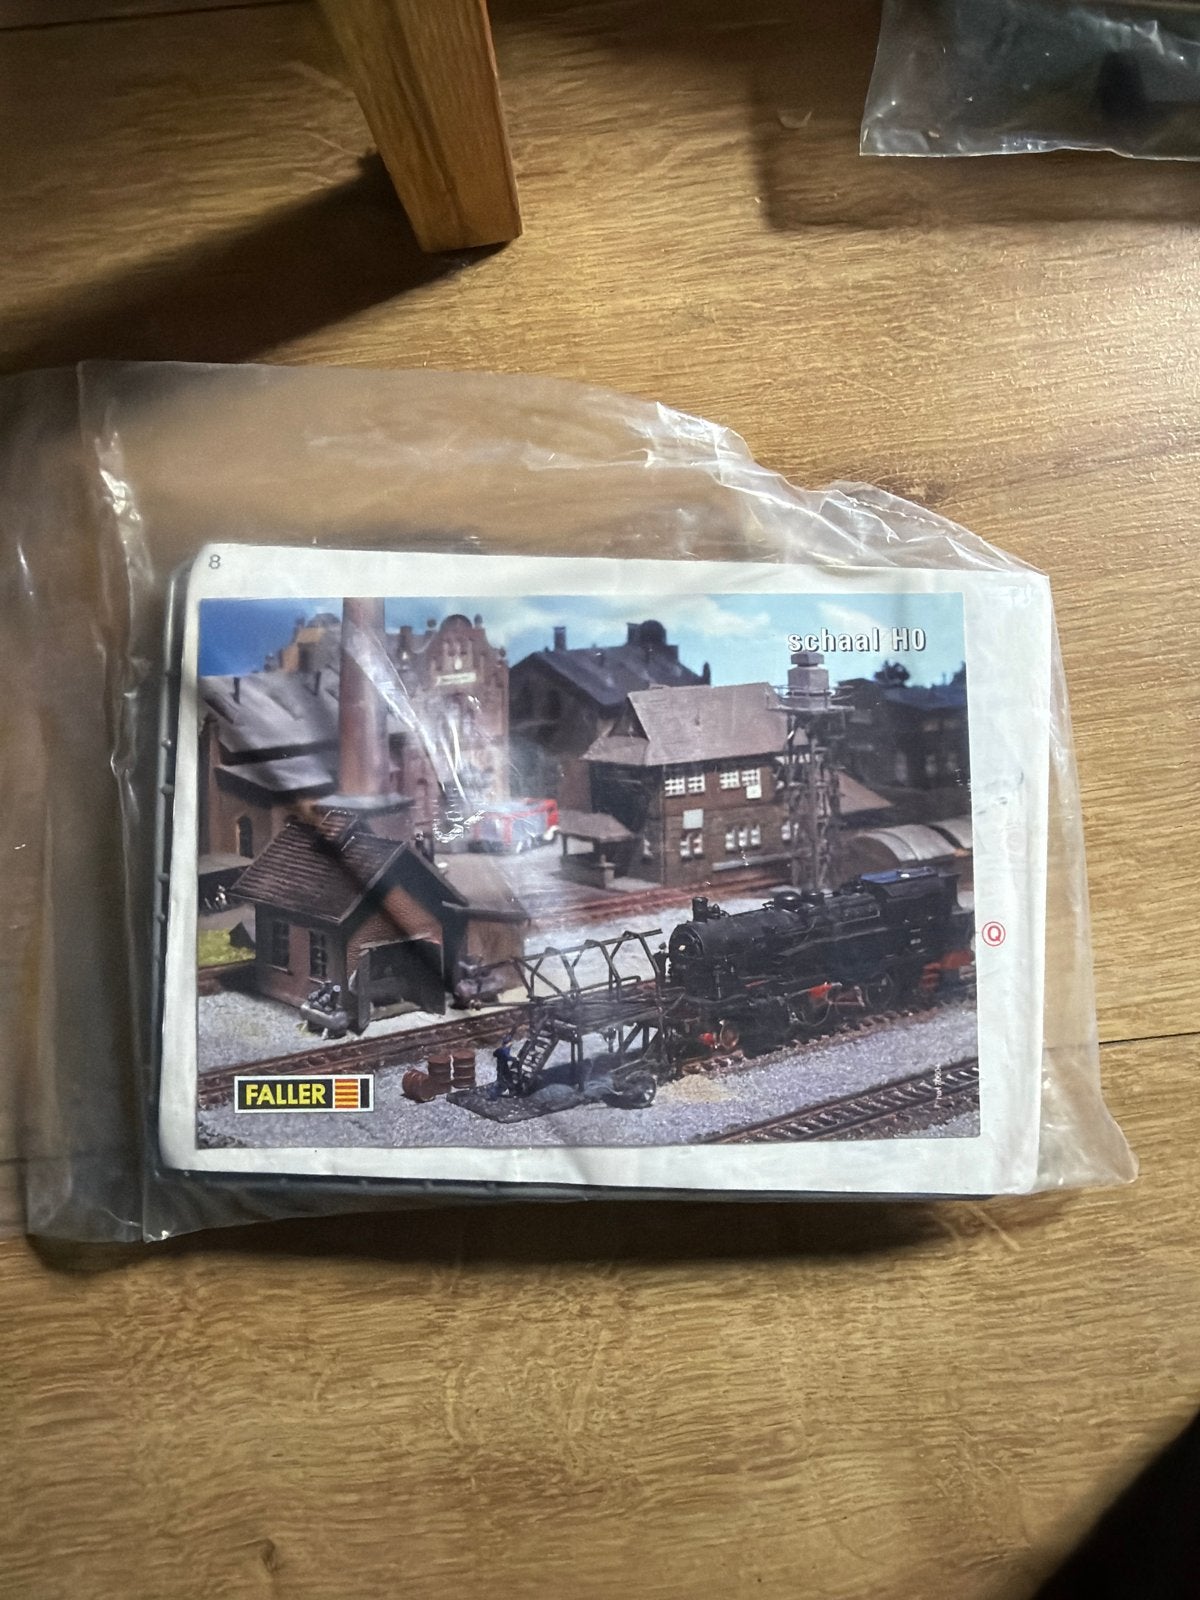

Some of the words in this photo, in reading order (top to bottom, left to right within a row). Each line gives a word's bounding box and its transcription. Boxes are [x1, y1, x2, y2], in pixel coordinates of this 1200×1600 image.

[209, 554, 221, 569] 8
[788, 627, 880, 652] schaal
[245, 1083, 326, 1105] FALLER
